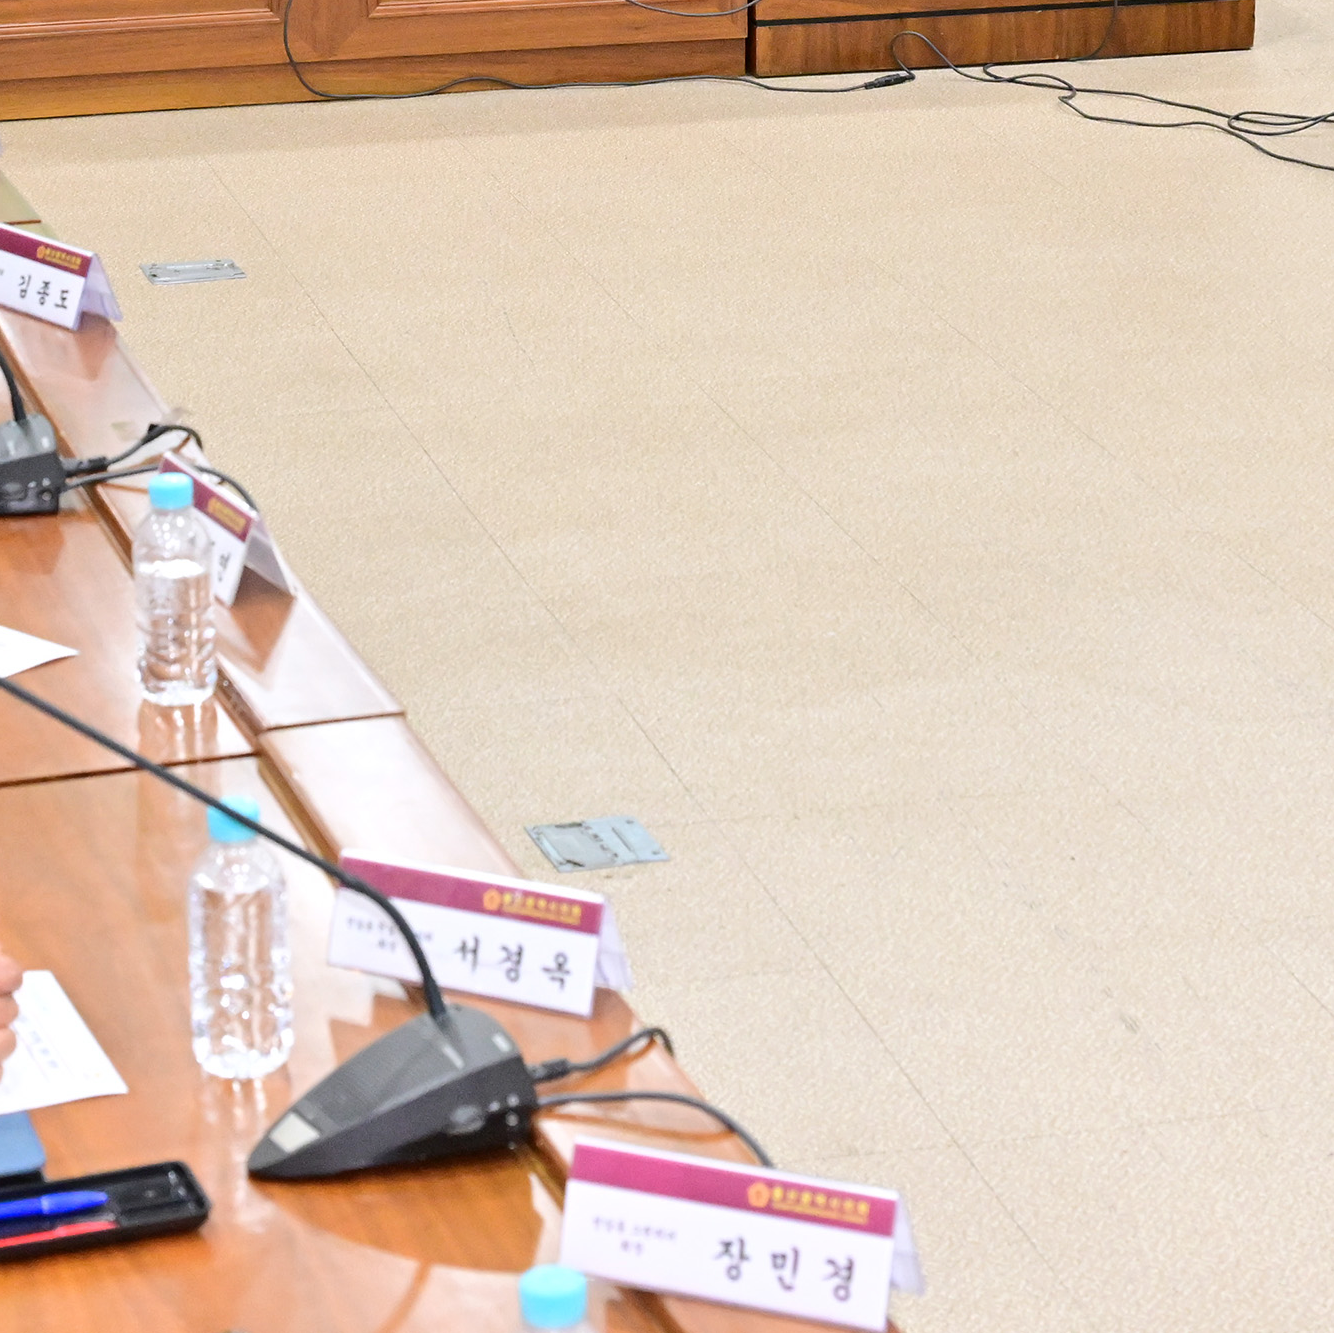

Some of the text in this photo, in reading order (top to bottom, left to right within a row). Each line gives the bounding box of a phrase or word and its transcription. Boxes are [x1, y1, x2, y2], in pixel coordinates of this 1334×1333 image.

[17, 274, 70, 310] 김종도
[453, 933, 572, 991] 서경옥
[713, 1235, 857, 1304] 장민경
